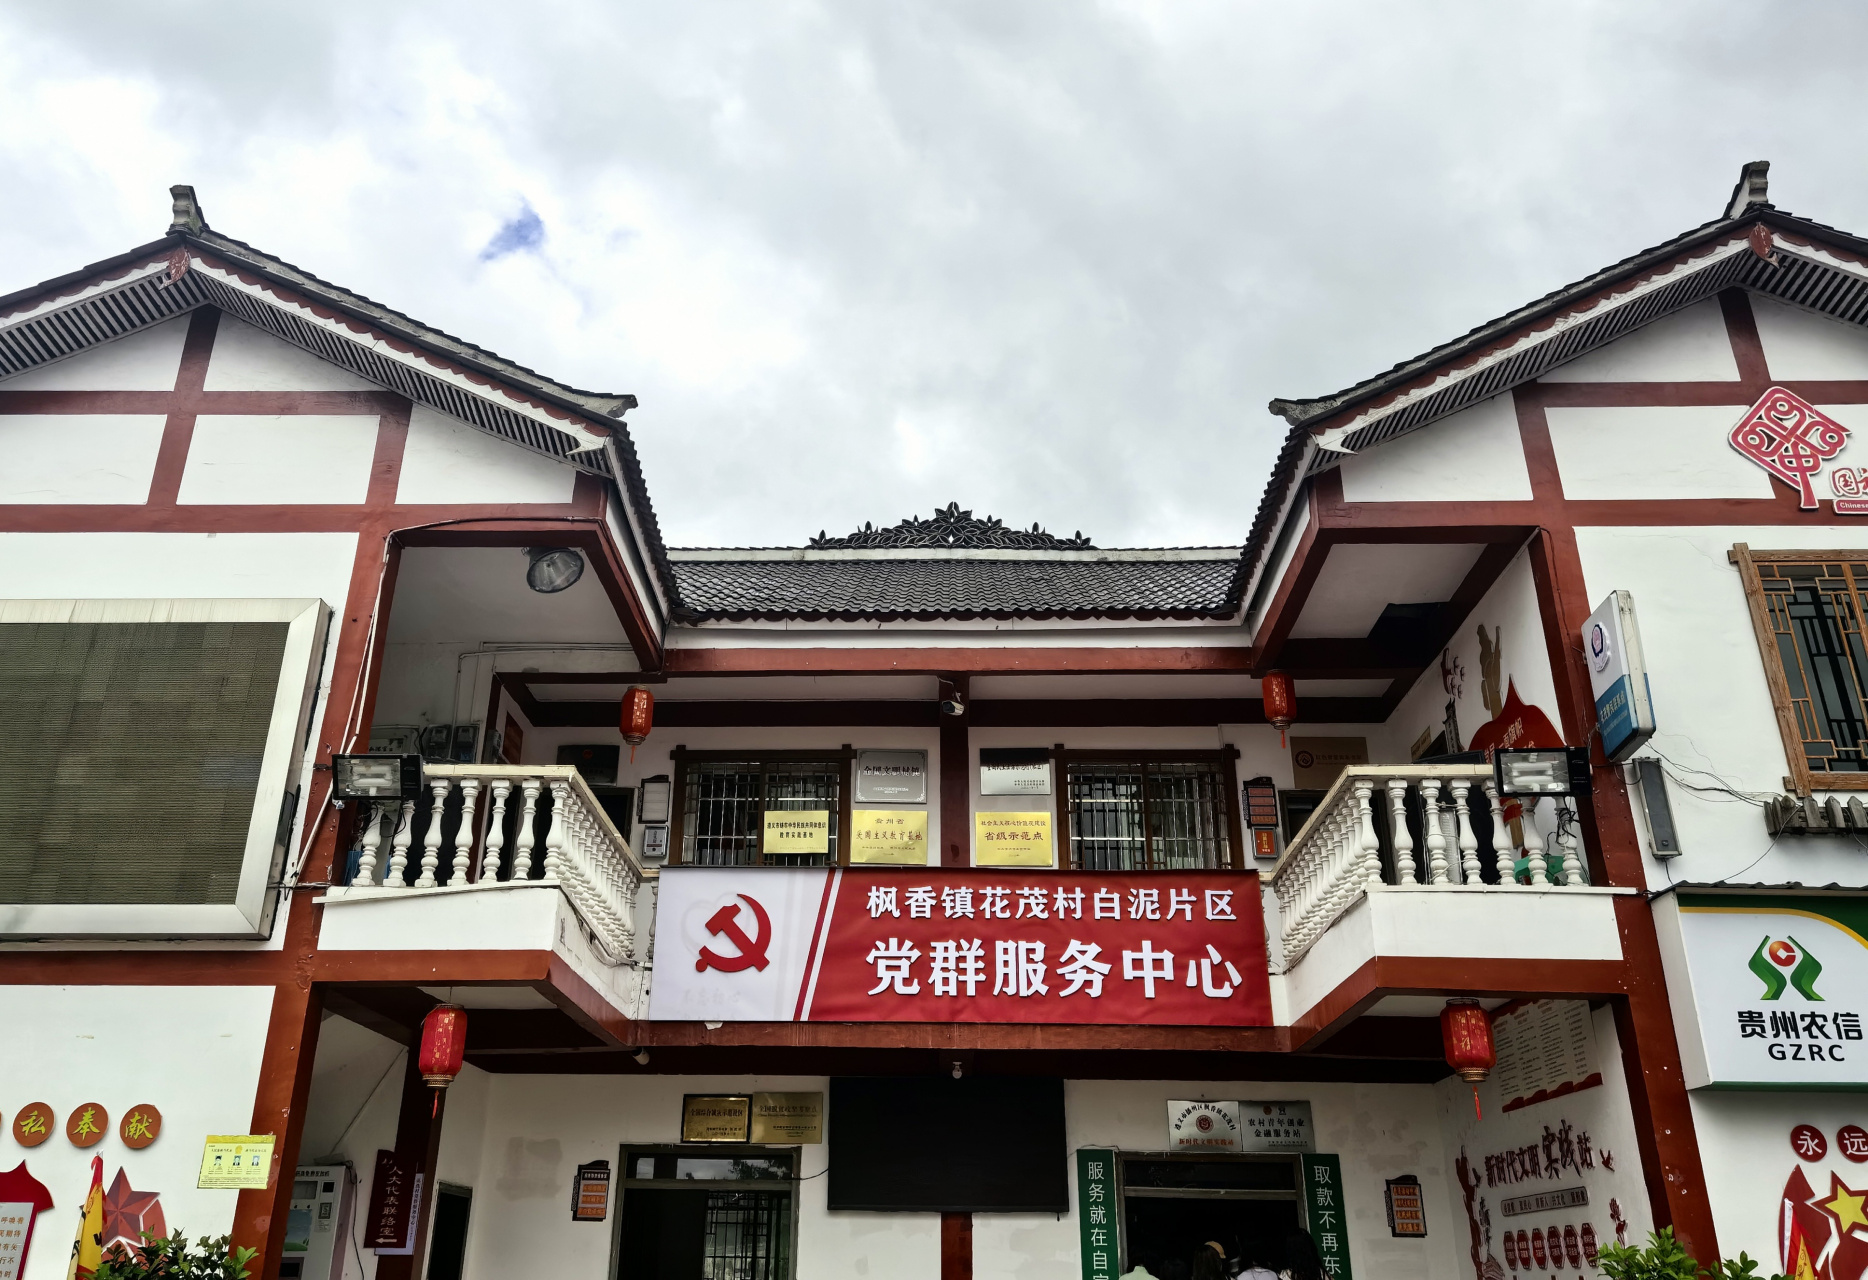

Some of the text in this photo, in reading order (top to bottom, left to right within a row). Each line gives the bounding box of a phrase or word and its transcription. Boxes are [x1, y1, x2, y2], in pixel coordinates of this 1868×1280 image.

[863, 766, 920, 777] 全国文明村镇
[985, 831, 1043, 841] 省级示范点
[866, 886, 1237, 921] 枫香镇花茂村白泥片区
[866, 938, 1242, 998] 党群服务中心
[1737, 1010, 1863, 1040] 贵州农信
[1768, 1043, 1845, 1062] GZRC
[20, 1107, 153, 1140] 私奉献
[1247, 1118, 1305, 1127] 农村青年创业
[1254, 1128, 1301, 1138] 金融服务站
[1178, 1138, 1234, 1146] 新时代文明实践站
[1797, 1131, 1868, 1157] 永远
[1484, 1119, 1595, 1188] 新时代文明实践站
[380, 1165, 402, 1236] 人大代表联络室
[1314, 1165, 1341, 1275] 取款不再东
[0, 1243, 17, 1252] 有关
[0, 1271, 11, 1279] 时
